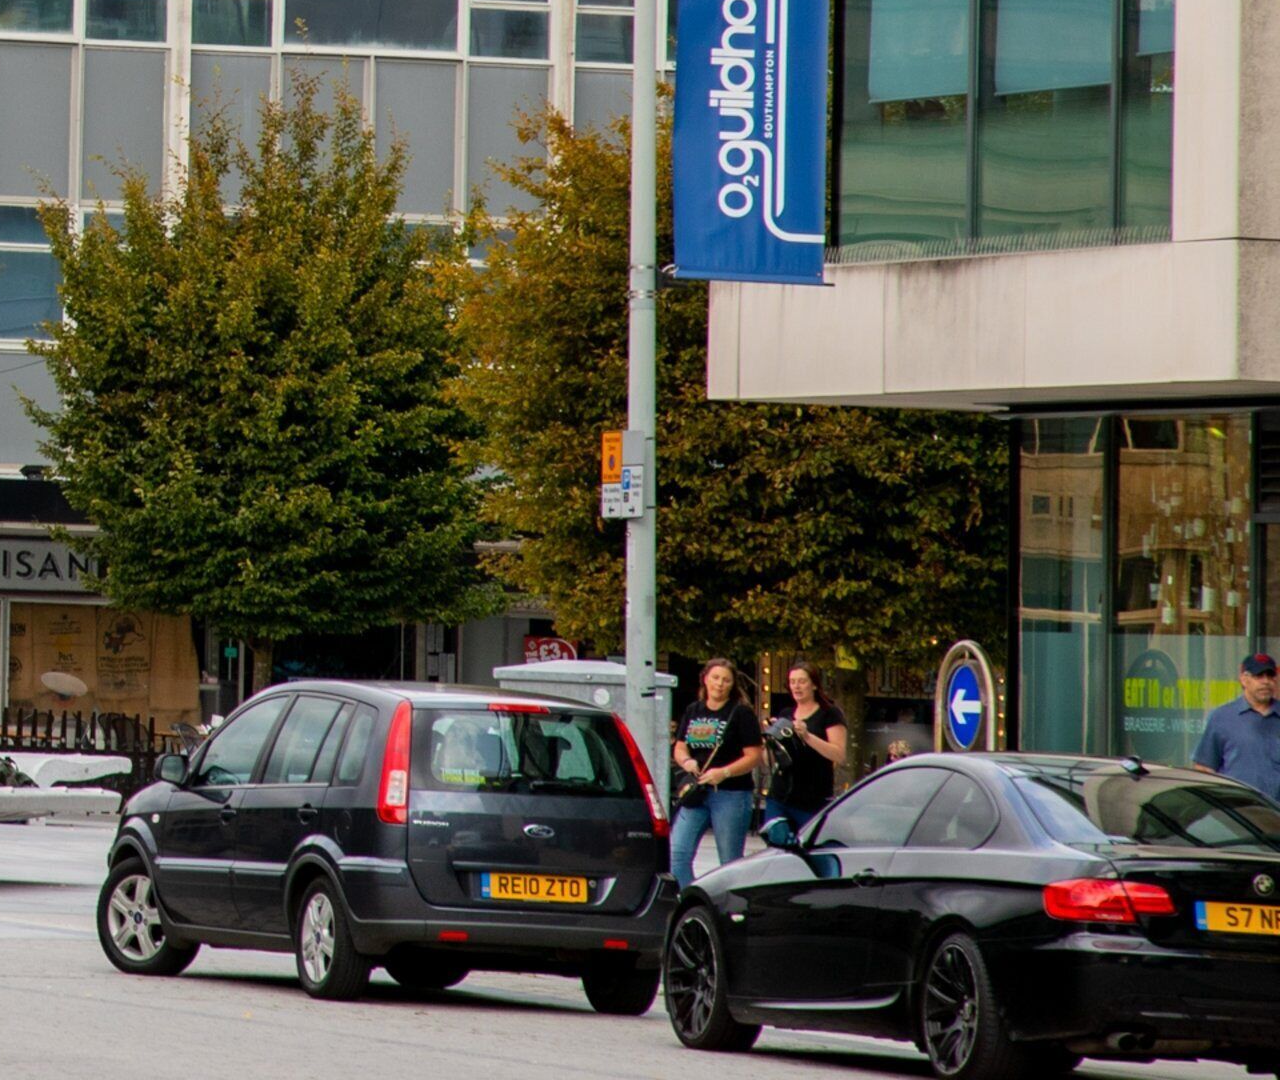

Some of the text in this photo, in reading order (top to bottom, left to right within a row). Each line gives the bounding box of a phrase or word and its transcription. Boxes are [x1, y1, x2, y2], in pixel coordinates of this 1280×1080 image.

[764, 49, 775, 139] SOUTHAMPTON
[498, 876, 581, 898] RE10 ZTO
[1226, 906, 1253, 928] S7
